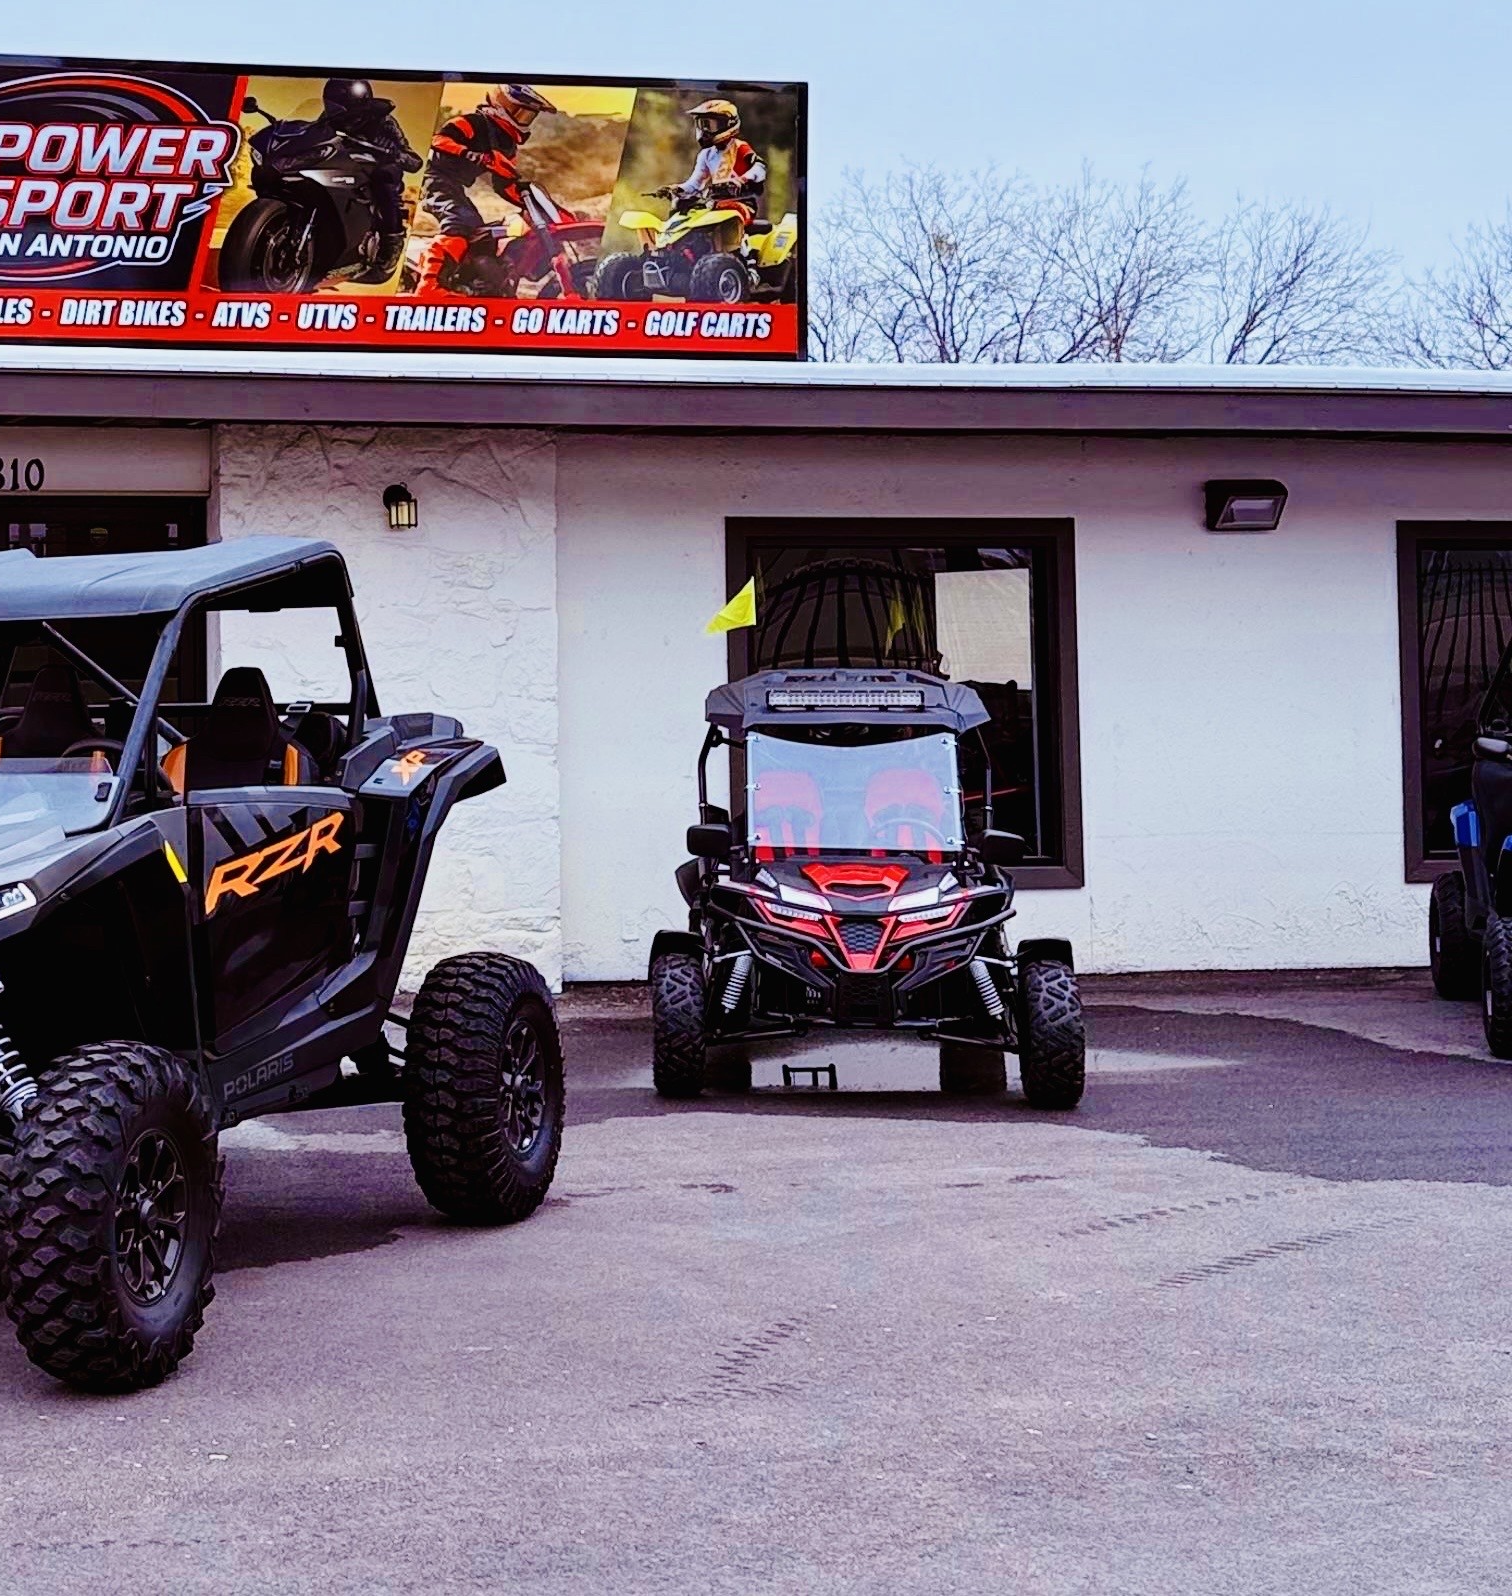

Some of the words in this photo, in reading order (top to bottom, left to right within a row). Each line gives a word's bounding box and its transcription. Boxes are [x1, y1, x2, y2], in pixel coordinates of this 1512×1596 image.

[25, 234, 168, 259] ANTONIO
[60, 299, 118, 325] DIRT
[118, 300, 186, 326] BIKES
[211, 302, 272, 328] ATVS
[297, 304, 357, 330] UTVS
[385, 305, 486, 333] TRAILERS
[511, 308, 544, 334] GO
[547, 309, 620, 335] KARTS
[645, 311, 698, 337] GOLF
[700, 312, 772, 339] CARTS
[391, 749, 426, 786] XP
[204, 811, 345, 915] RZR
[223, 1053, 295, 1101] POLARIS
